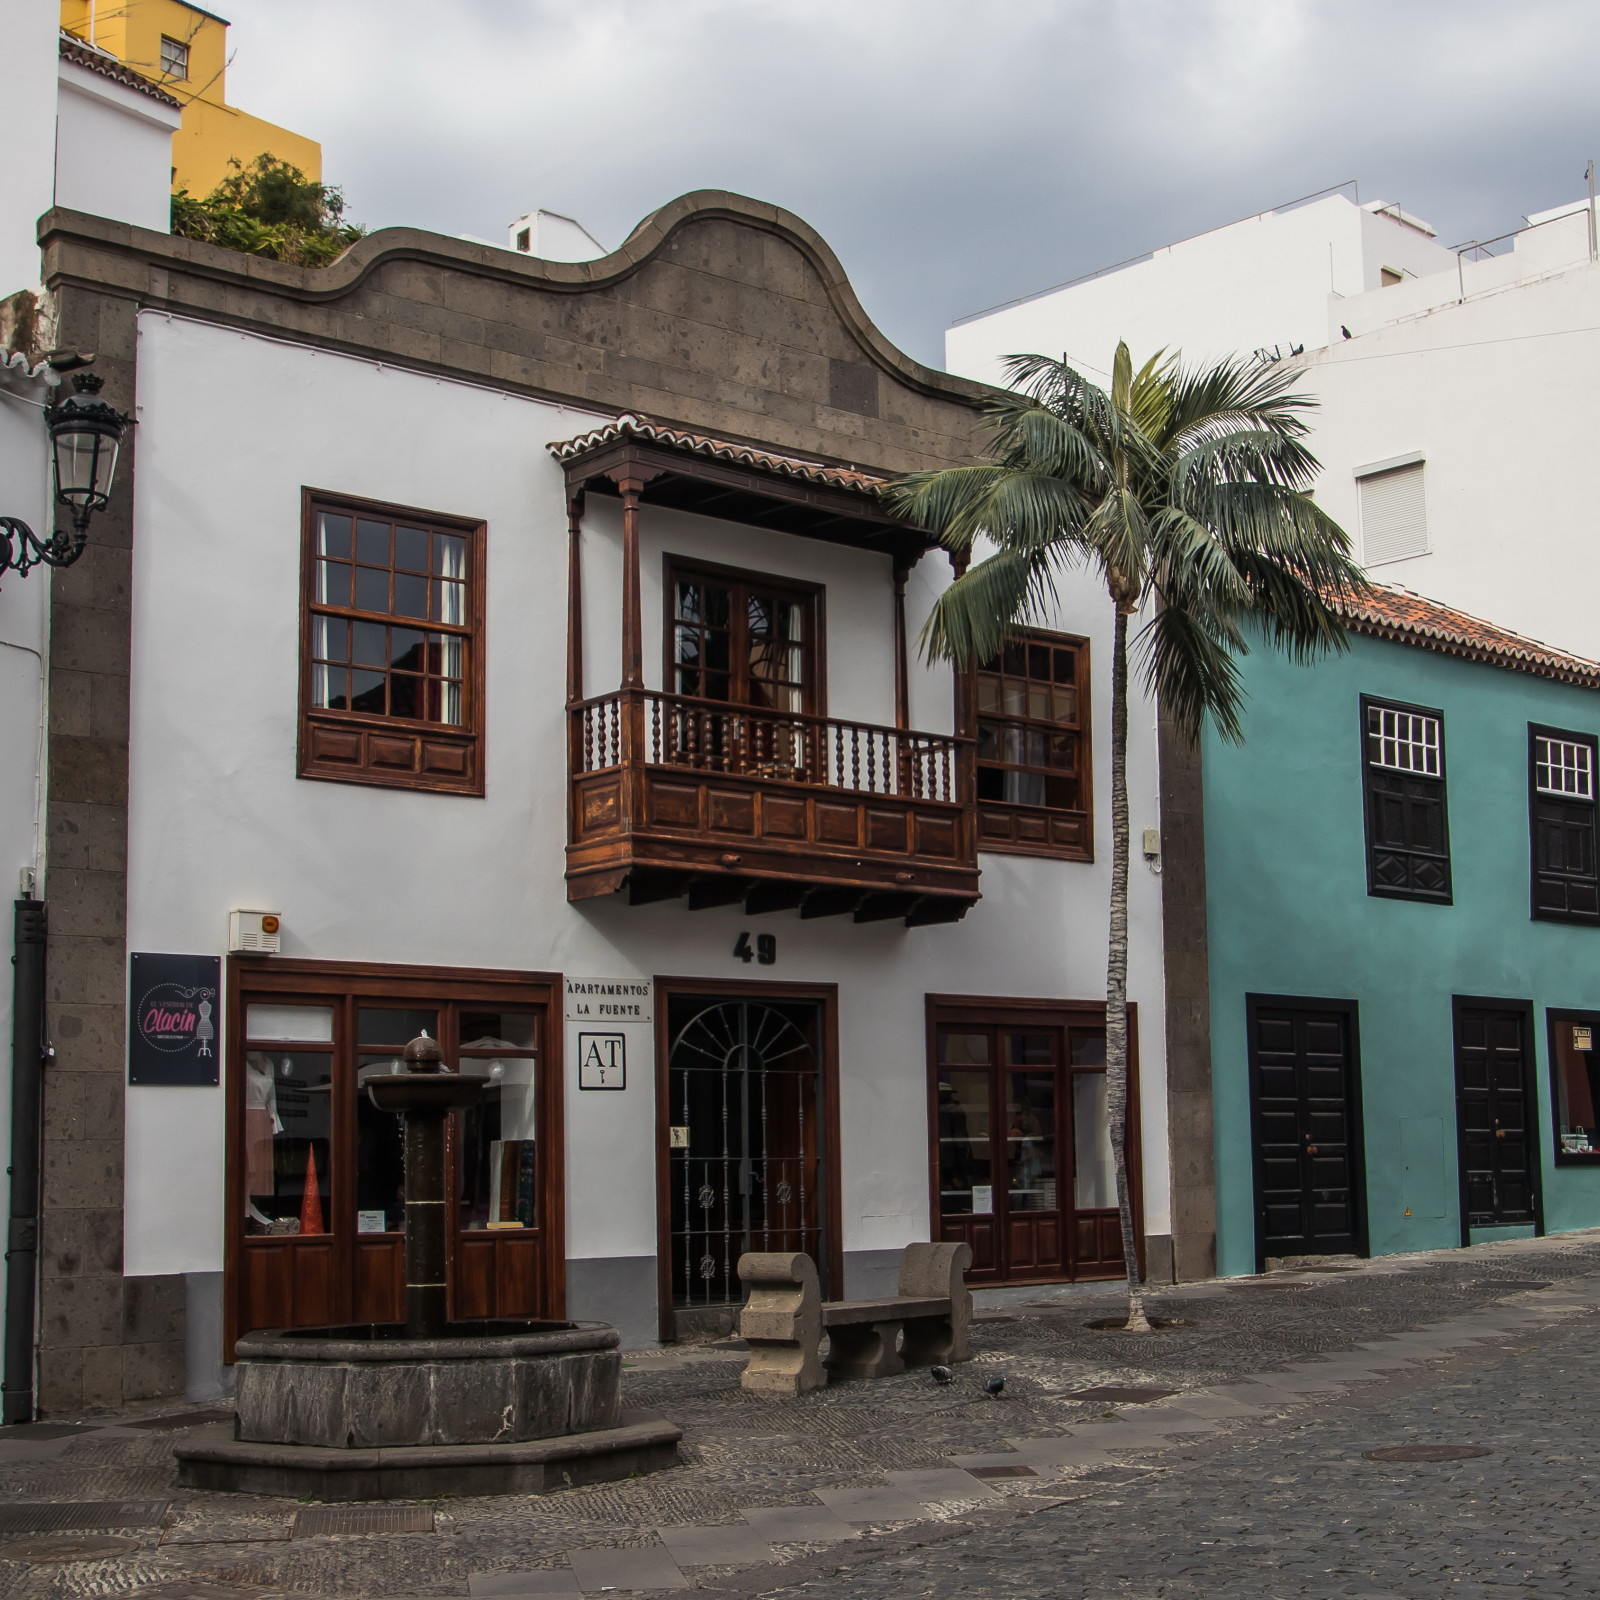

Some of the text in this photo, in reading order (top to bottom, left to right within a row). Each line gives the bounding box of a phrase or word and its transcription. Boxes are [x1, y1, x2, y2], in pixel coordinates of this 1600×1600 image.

[733, 931, 776, 965] 49
[567, 983, 648, 996] APARTAMENTOS
[144, 1008, 195, 1033] Clacin
[577, 1004, 640, 1015] LA FUENTE
[584, 1040, 621, 1067] AT
